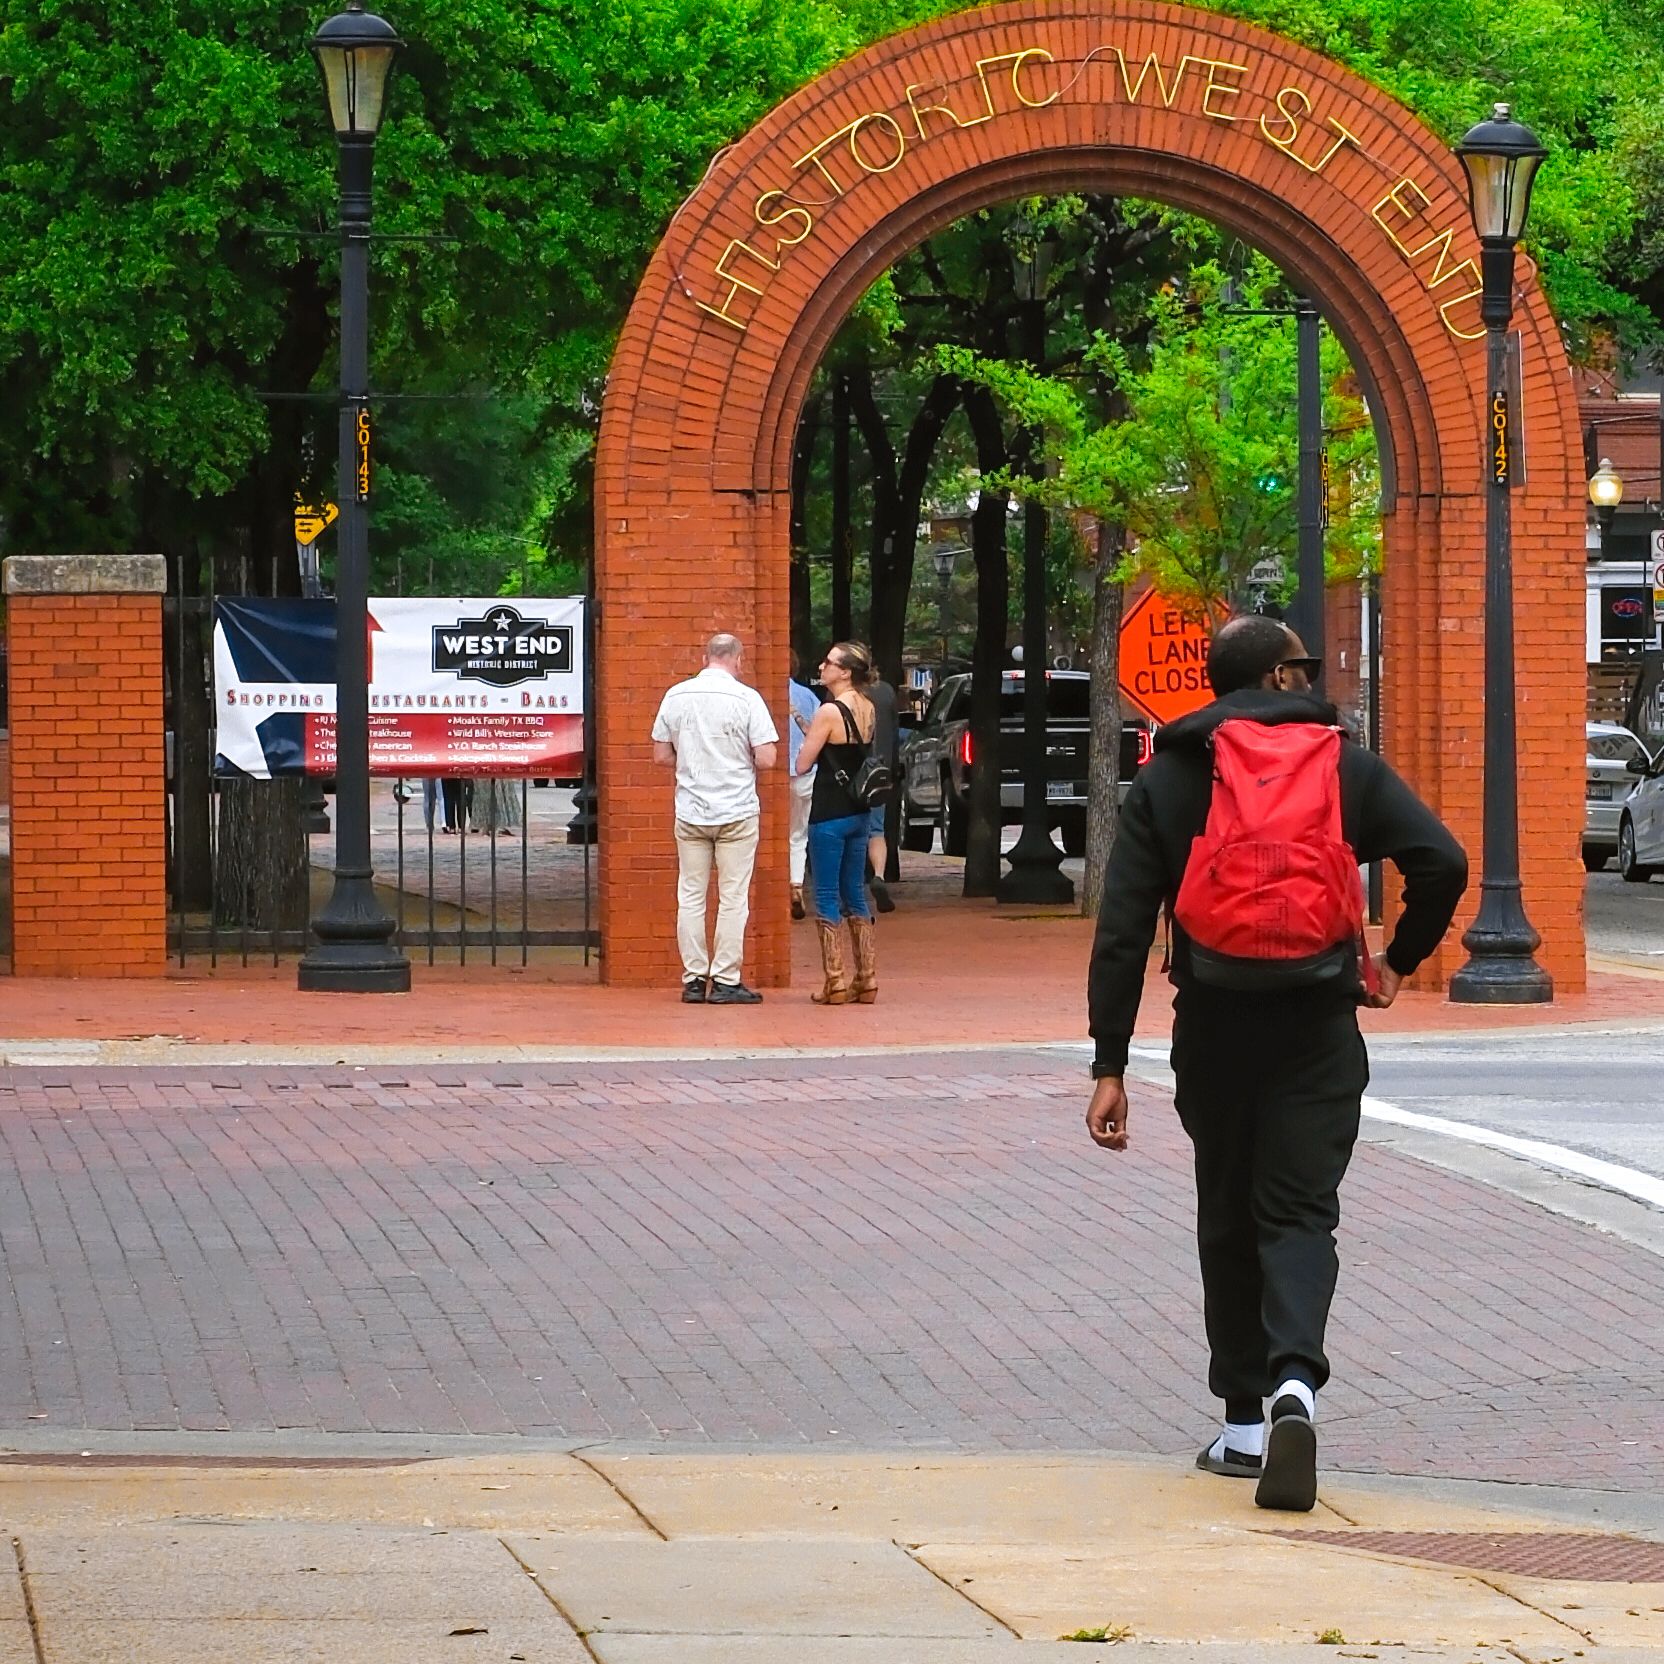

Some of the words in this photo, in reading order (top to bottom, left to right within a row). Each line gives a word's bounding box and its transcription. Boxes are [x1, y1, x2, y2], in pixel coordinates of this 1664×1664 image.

[695, 47, 1055, 329] HISTORIC
[1115, 47, 1362, 173] WEST
[1372, 176, 1489, 340] END
[442, 636, 508, 655] WEST
[515, 636, 562, 655] END
[467, 660, 501, 670] HISTORIC
[504, 660, 538, 670] DISTRICT
[1135, 667, 1212, 695] CLOSE
[227, 690, 324, 707] SHOPPING
[371, 694, 488, 708] ESTAURANTS
[521, 692, 569, 708] BARS
[484, 716, 509, 726] Family
